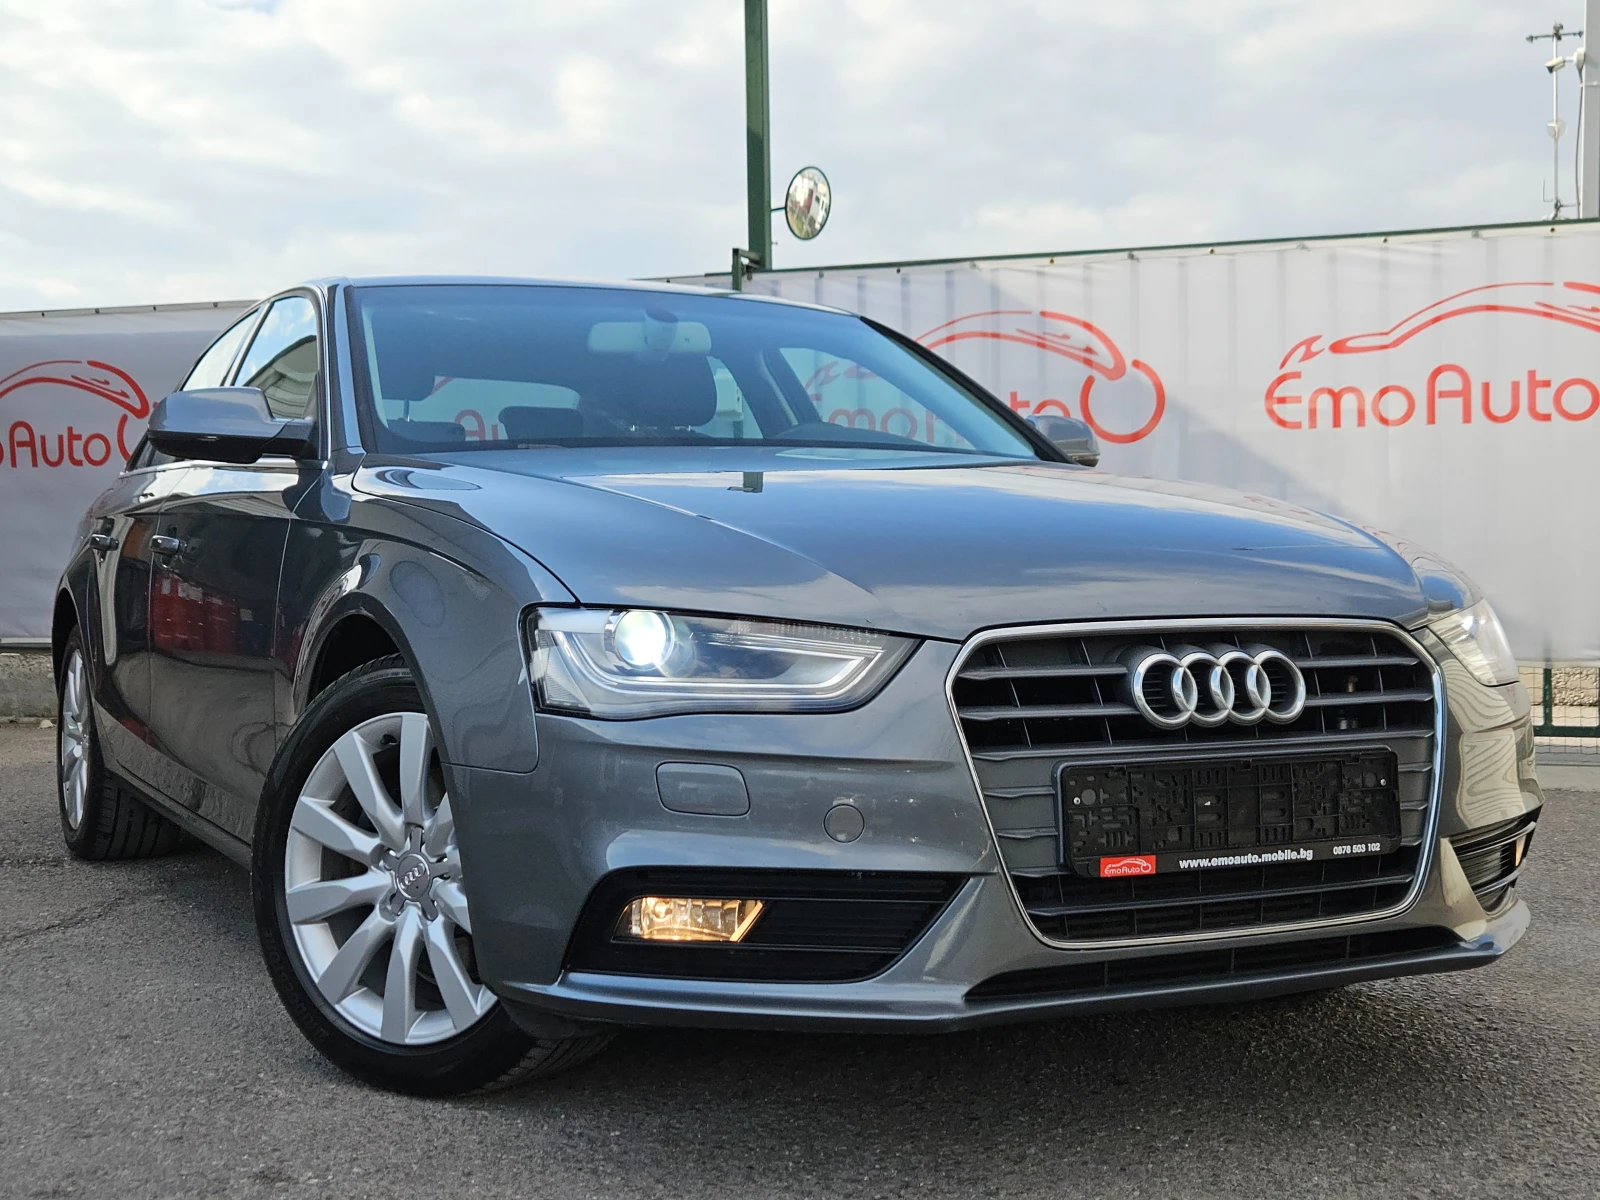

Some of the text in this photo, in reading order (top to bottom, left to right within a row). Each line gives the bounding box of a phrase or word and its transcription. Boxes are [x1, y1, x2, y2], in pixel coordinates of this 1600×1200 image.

[1264, 364, 1600, 430] EmoAuto
[0, 420, 111, 468] Auto
[1368, 842, 1380, 852] 102
[1179, 848, 1314, 869] www.emoauto.mobile.bg
[1104, 866, 1141, 876] EmoAuto
